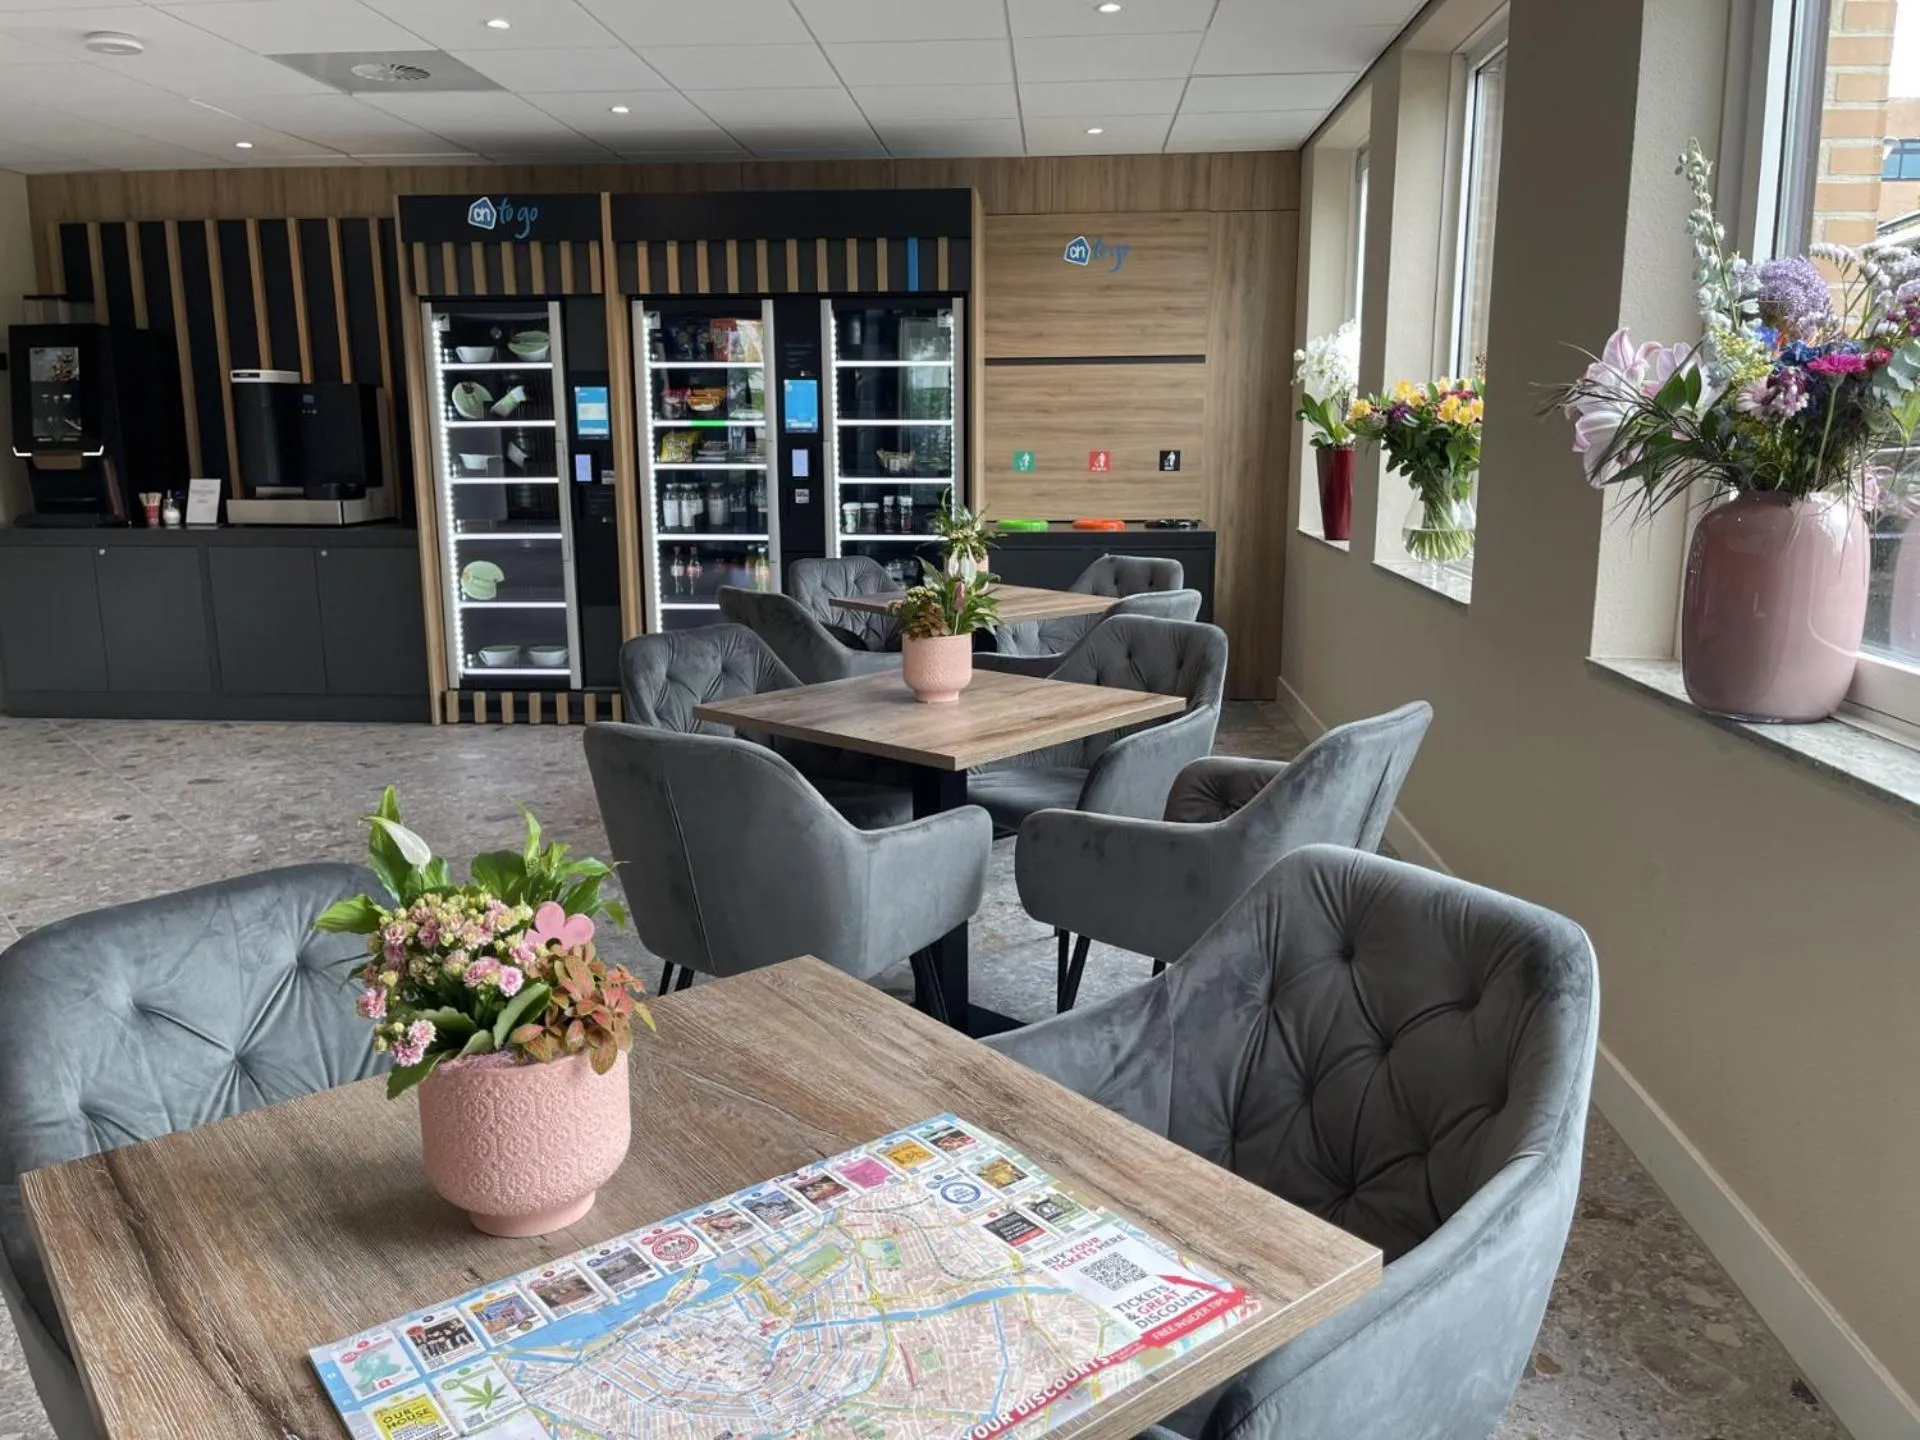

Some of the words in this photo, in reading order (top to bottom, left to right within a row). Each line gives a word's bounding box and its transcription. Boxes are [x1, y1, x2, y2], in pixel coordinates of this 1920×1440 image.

[497, 197, 513, 224] to
[514, 206, 538, 239] go
[1042, 1251, 1066, 1267] BUY
[1068, 1236, 1101, 1254] YOUR
[1051, 1247, 1098, 1272] TICKETS
[1096, 1233, 1127, 1250] HERE
[1112, 1284, 1170, 1313] TICKETS
[1124, 1311, 1140, 1321] &
[1137, 1289, 1181, 1316] GREAT
[382, 1408, 412, 1424] OUR
[386, 1406, 433, 1430] HOUSE
